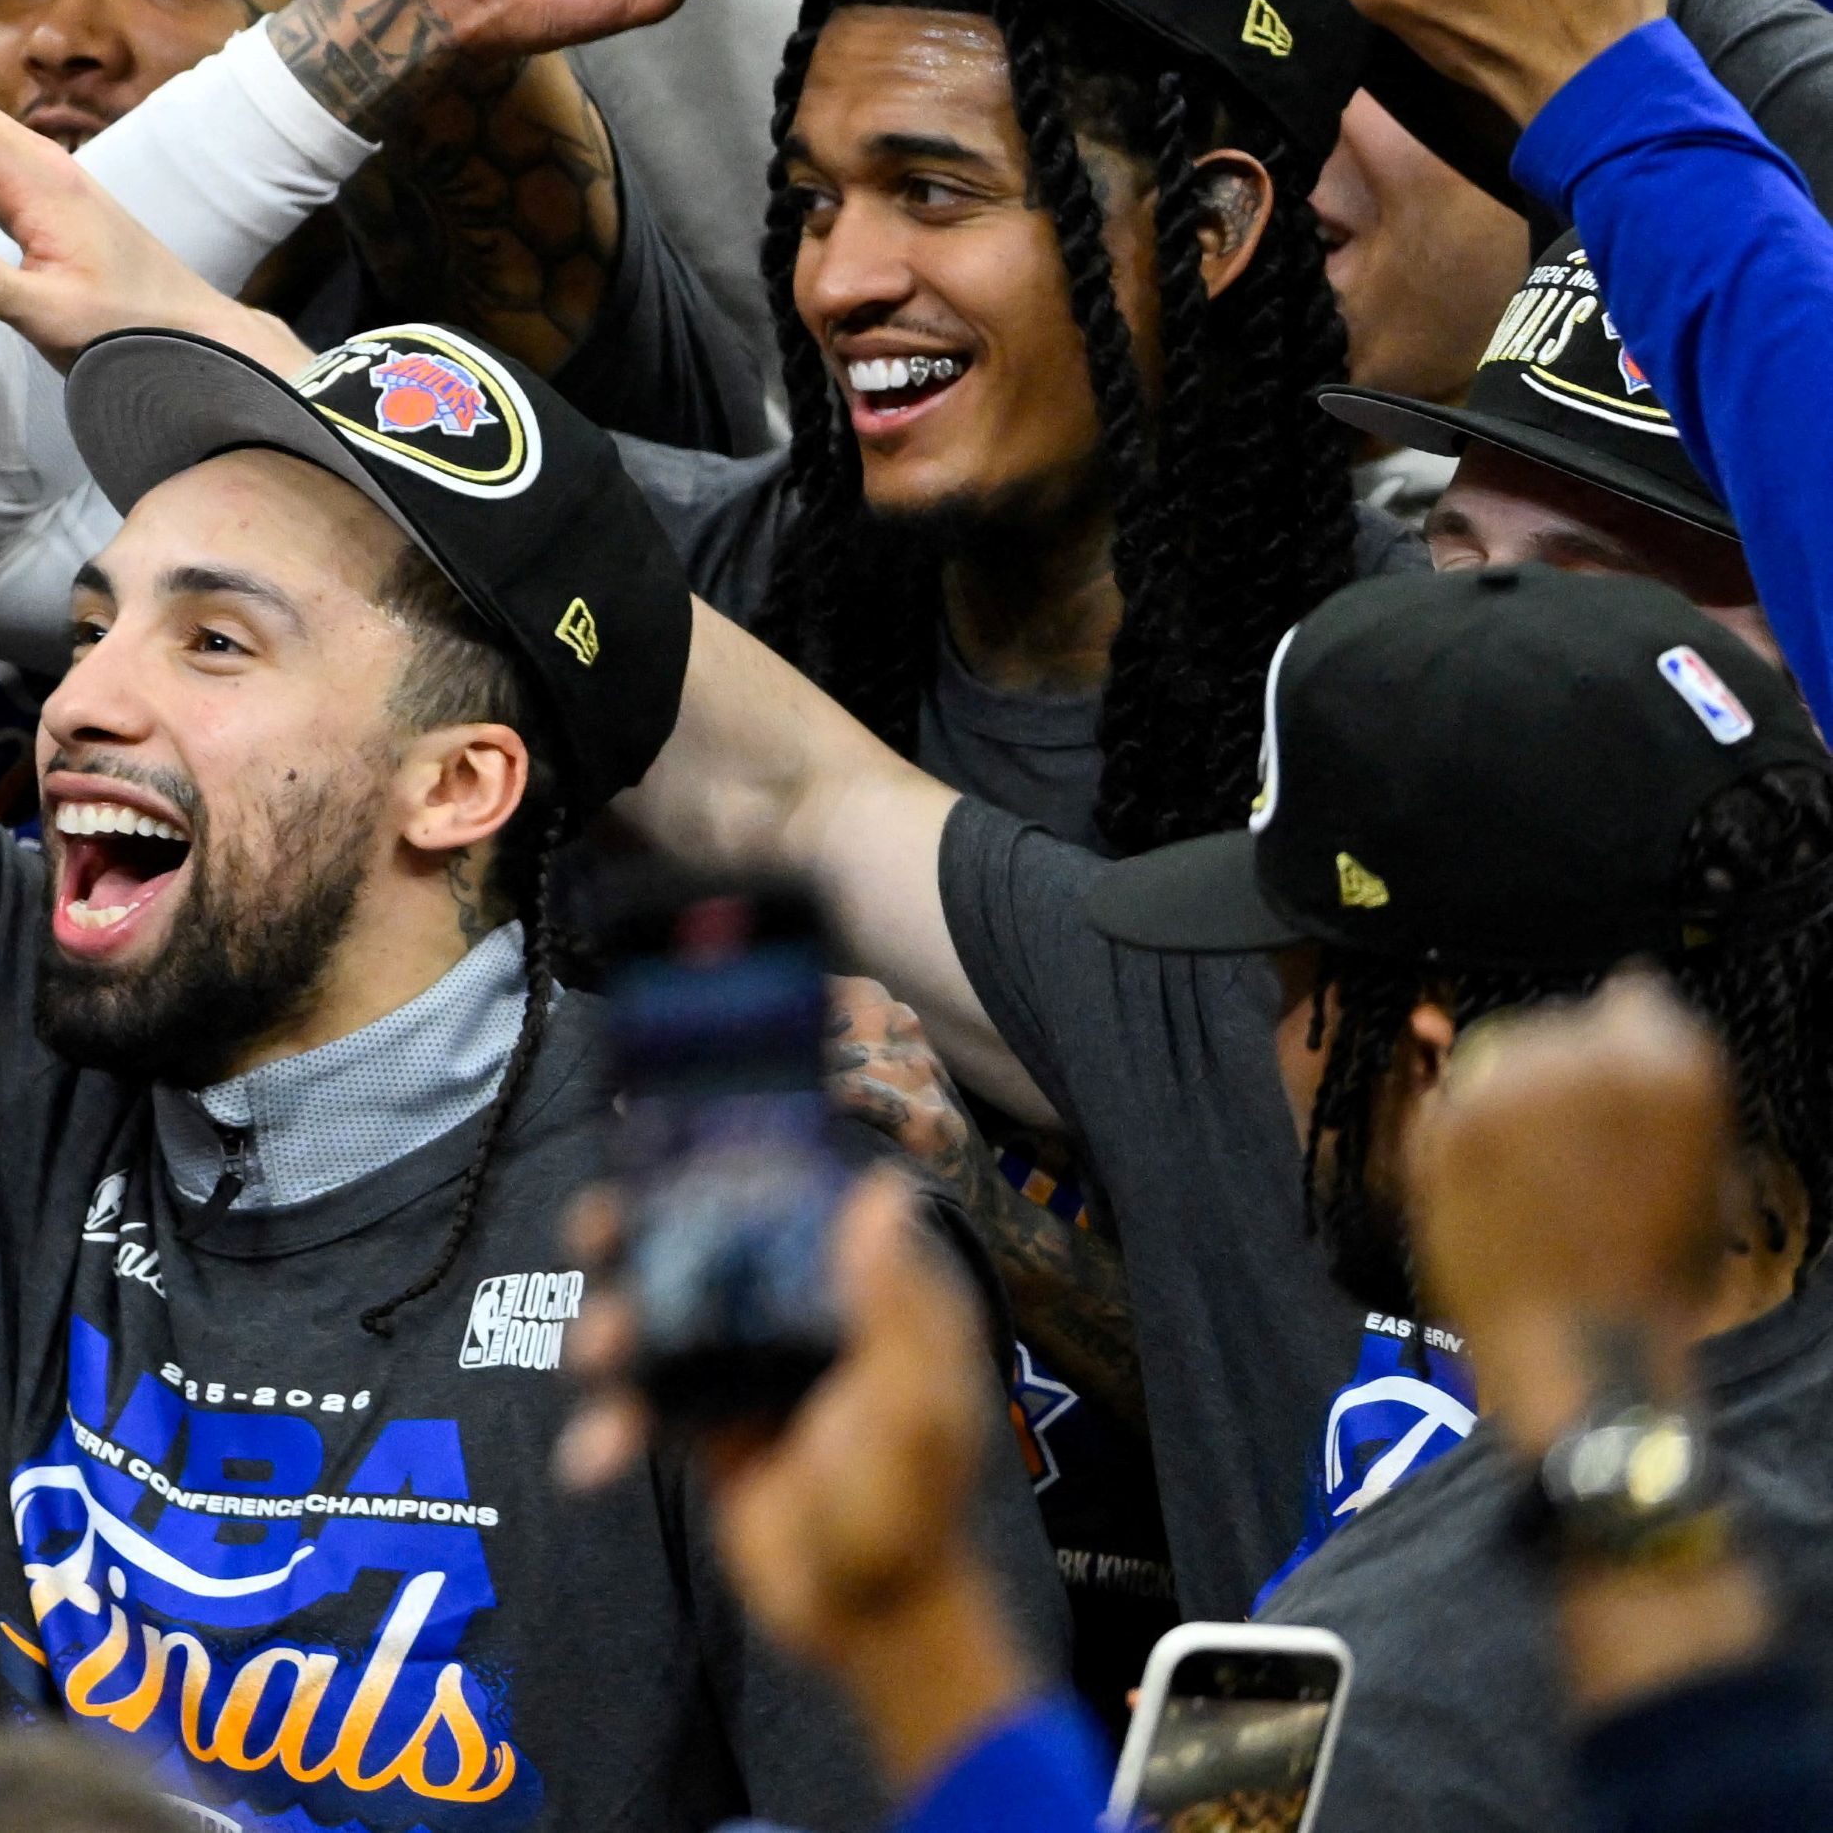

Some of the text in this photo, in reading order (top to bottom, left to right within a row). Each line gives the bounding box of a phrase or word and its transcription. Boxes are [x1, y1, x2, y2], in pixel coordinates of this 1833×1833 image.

[1526, 265, 1571, 287] 2026
[375, 357, 482, 432] KNICKS
[511, 1270, 585, 1321] LOCKER
[1364, 1311, 1466, 1354] EASERN
[127, 1458, 304, 1517] CONFERENCE
[304, 1493, 500, 1527] CHAMPIONS
[0, 1464, 517, 1804] Finals
